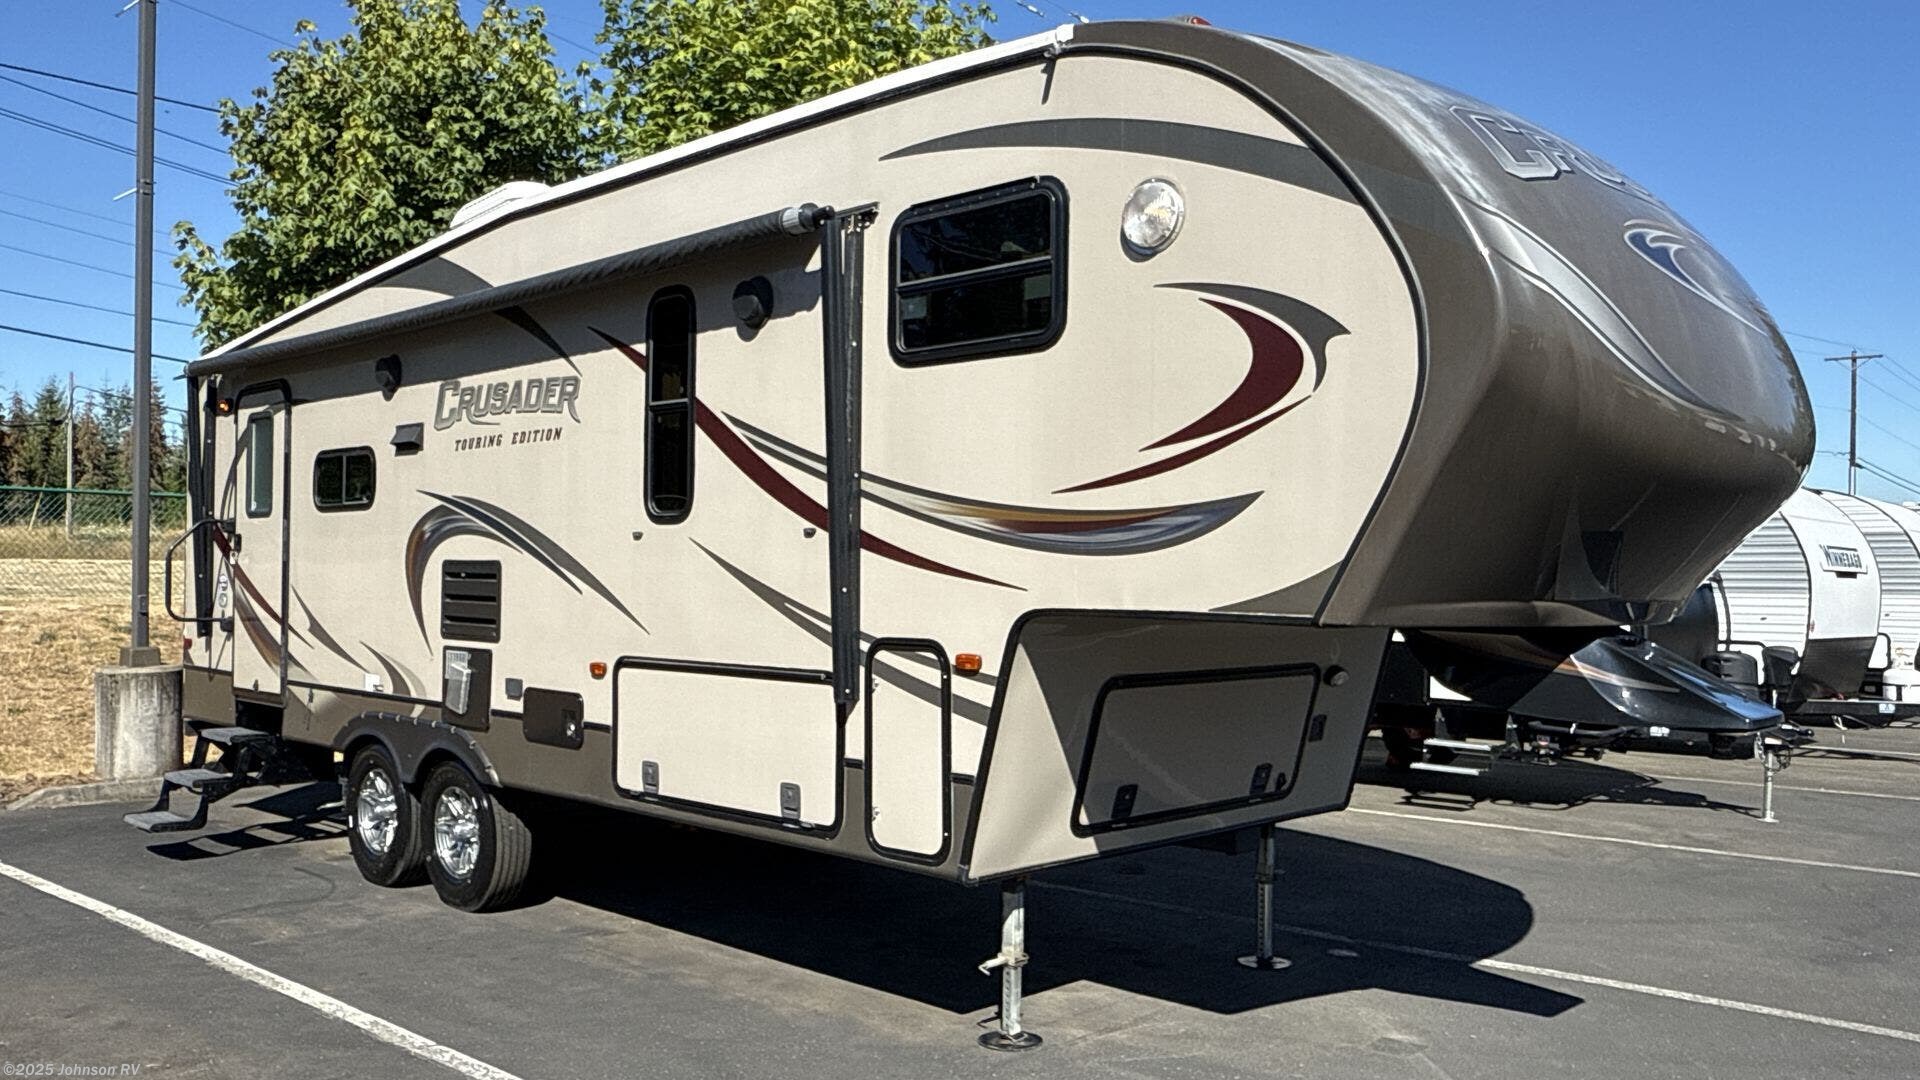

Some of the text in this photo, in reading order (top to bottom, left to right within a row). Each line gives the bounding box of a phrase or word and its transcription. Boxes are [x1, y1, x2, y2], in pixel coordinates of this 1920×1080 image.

[434, 375, 581, 431] CRUSADER
[455, 427, 563, 451] TOURING EDITION
